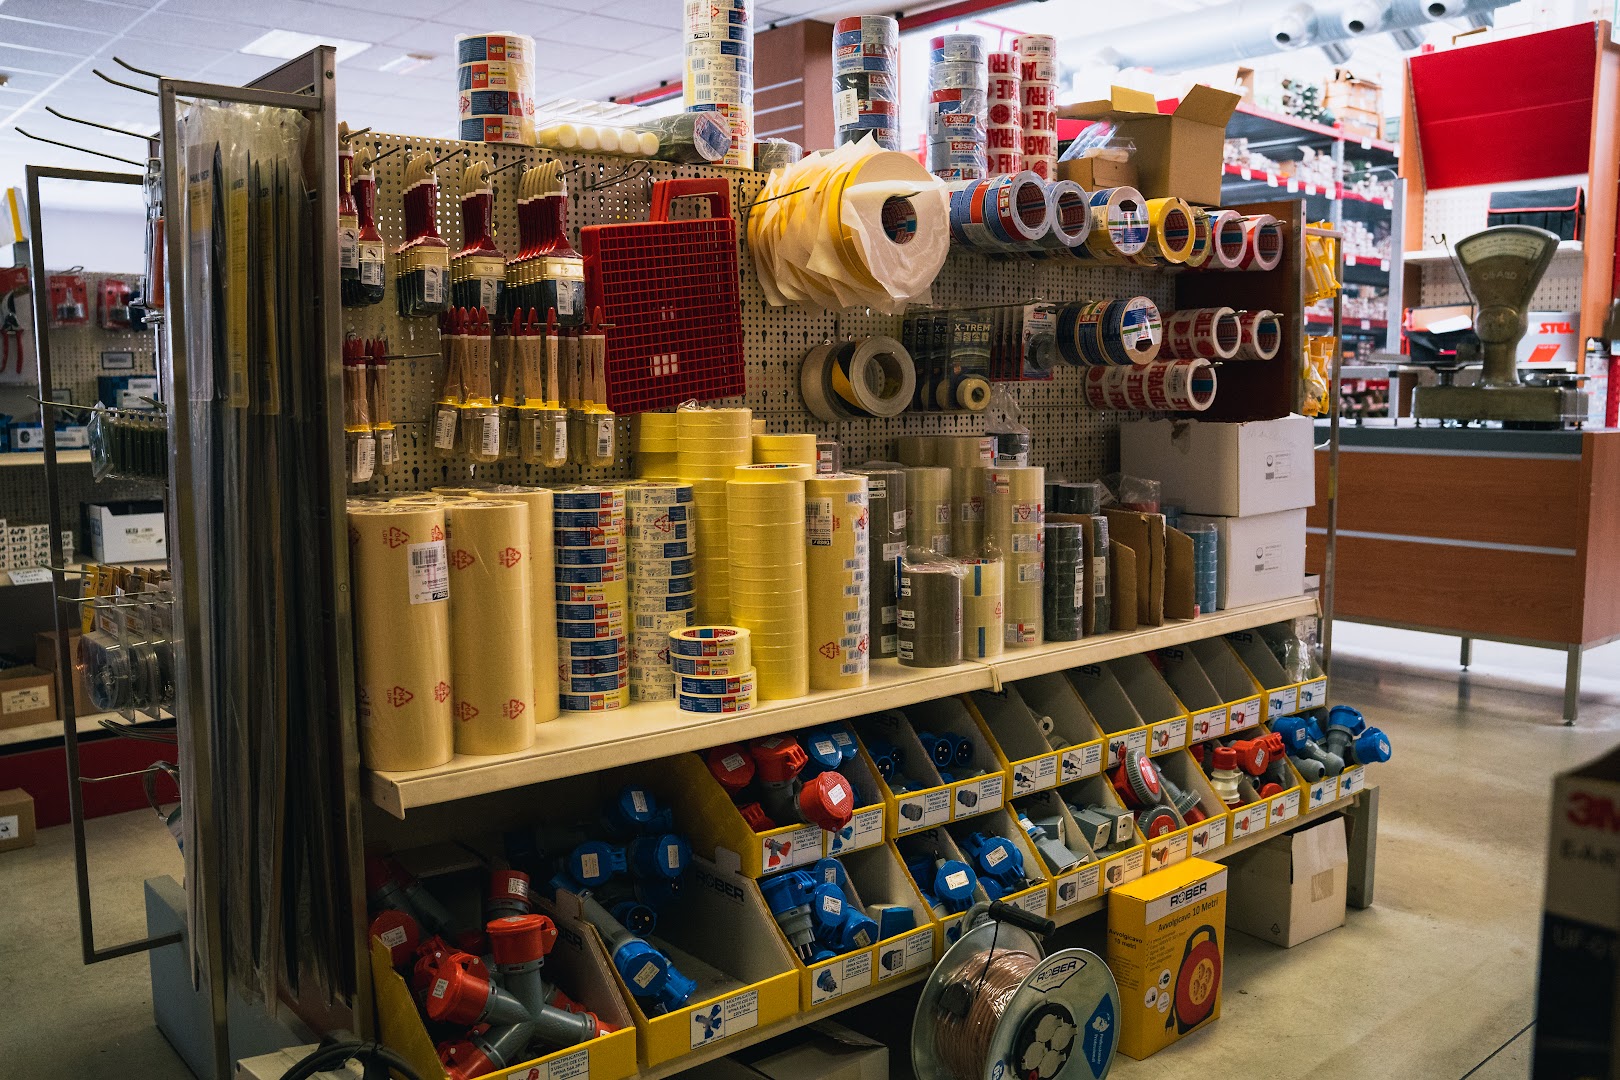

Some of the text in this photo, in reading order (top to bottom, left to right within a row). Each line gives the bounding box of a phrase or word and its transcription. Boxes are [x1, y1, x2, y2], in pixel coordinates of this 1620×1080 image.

[949, 115, 968, 123] tesa
[953, 142, 973, 150] tesa
[1170, 882, 1207, 907] ROBER
[1158, 897, 1219, 932] Avvolgicavo 10 Metri
[1108, 928, 1143, 944] Avvolgicavo
[1121, 940, 1137, 950] metri
[1036, 961, 1077, 983] ROBER
